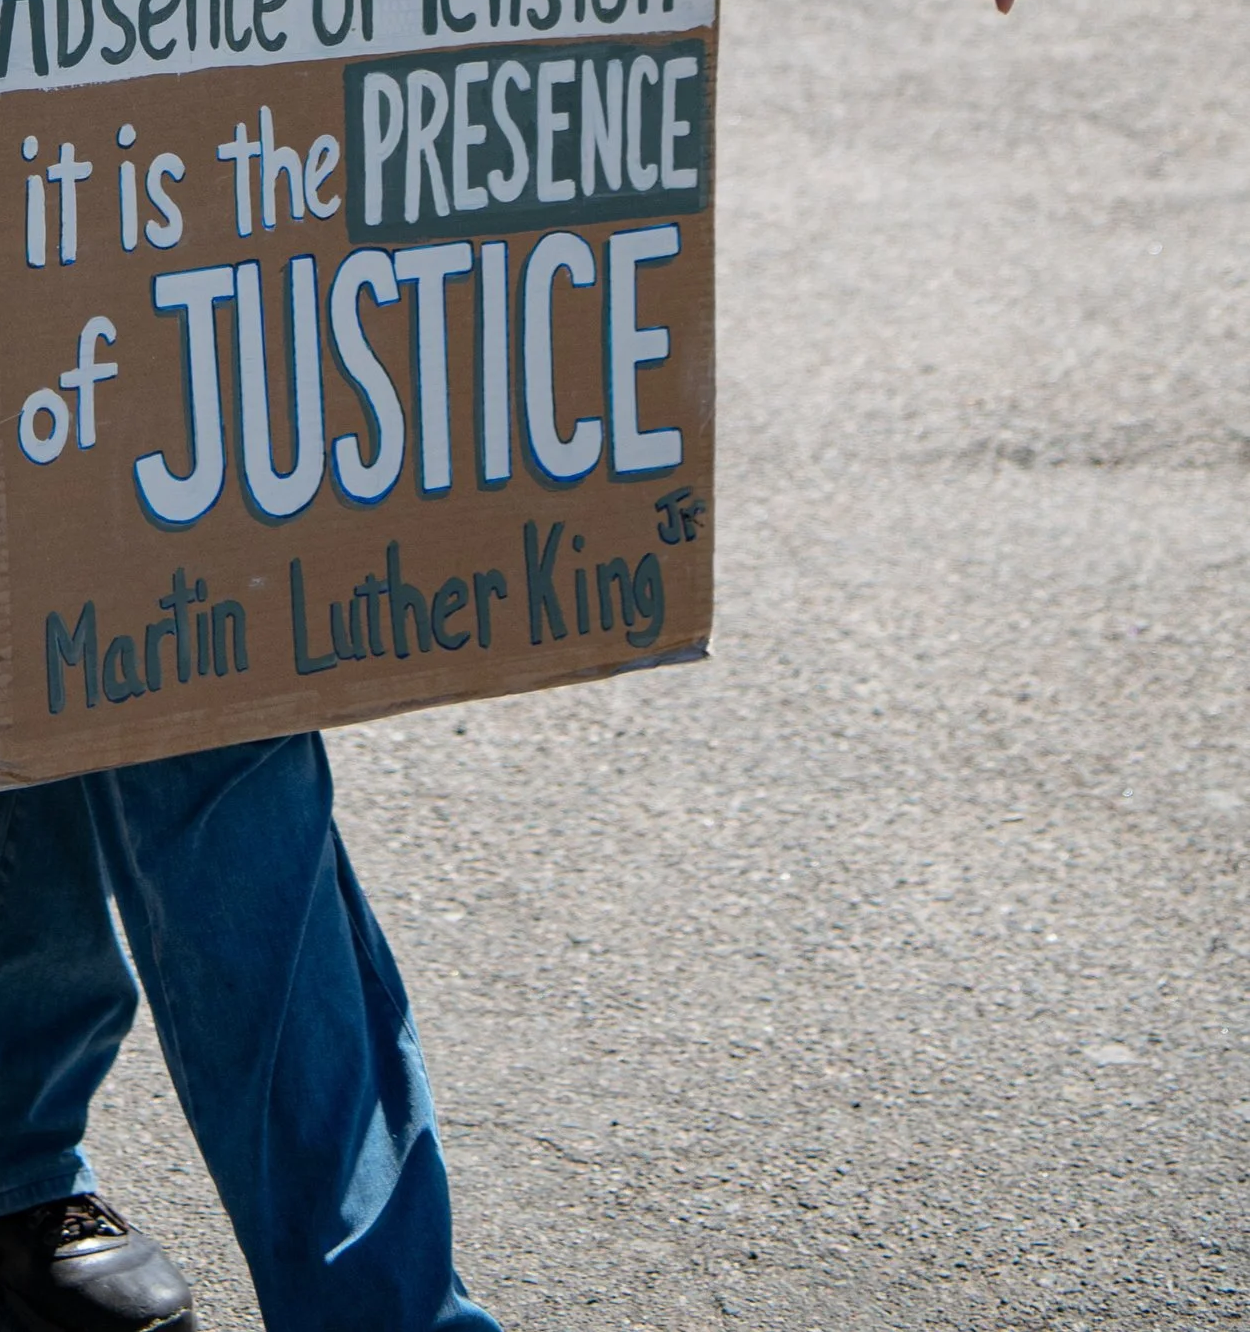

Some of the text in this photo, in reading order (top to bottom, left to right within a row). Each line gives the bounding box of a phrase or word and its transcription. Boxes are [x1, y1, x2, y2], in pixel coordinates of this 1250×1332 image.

[21, 55, 699, 269] it is the PRESENCE
[18, 223, 683, 529] of JUSTICE
[45, 486, 707, 715] Martin Luther King Jr
